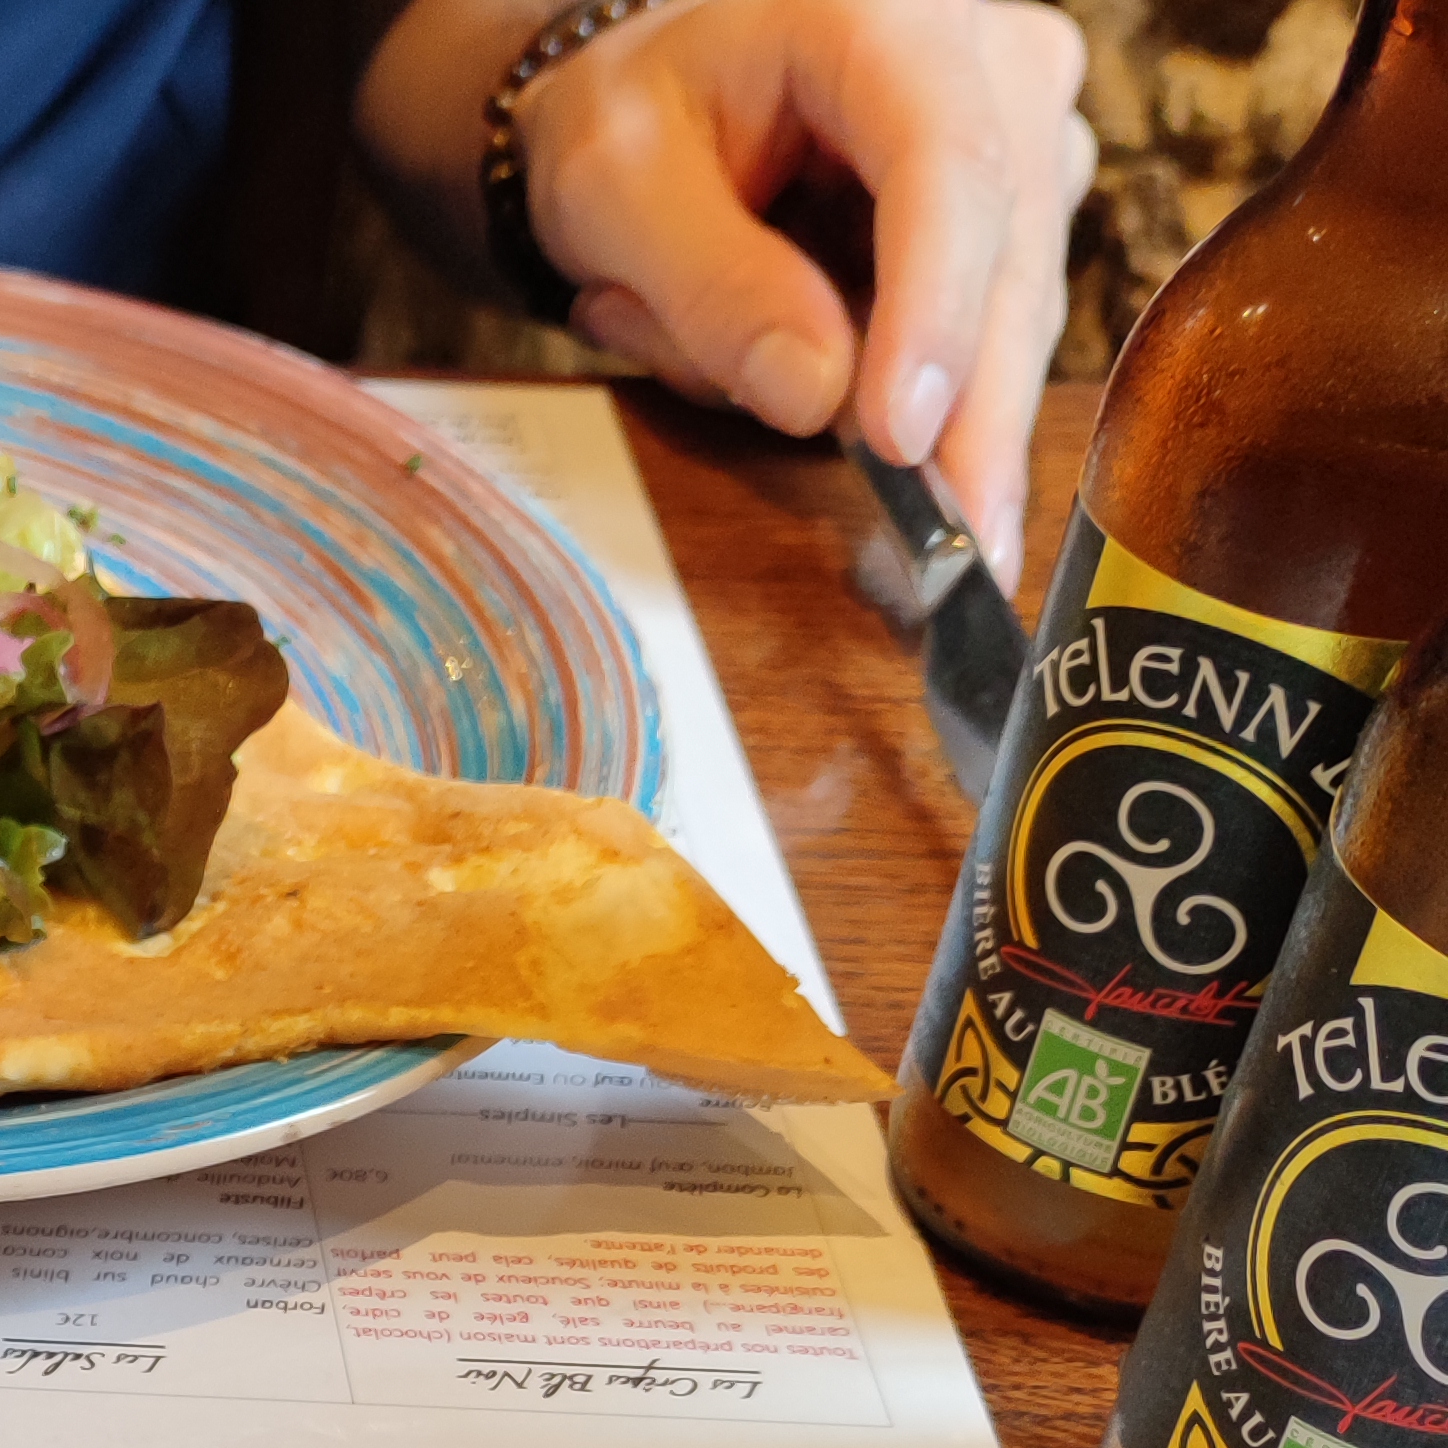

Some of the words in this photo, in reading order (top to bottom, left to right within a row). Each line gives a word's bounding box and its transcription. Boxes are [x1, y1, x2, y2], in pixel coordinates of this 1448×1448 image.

[1033, 617, 1321, 760] TELENN
[973, 862, 1001, 980] BIÈRE
[987, 989, 1038, 1041] AU
[1151, 1064, 1228, 1106] BLÉ
[1028, 1068, 1108, 1130] AB
[1201, 1244, 1238, 1376] BIÈRE
[1220, 1391, 1277, 1448] AU
